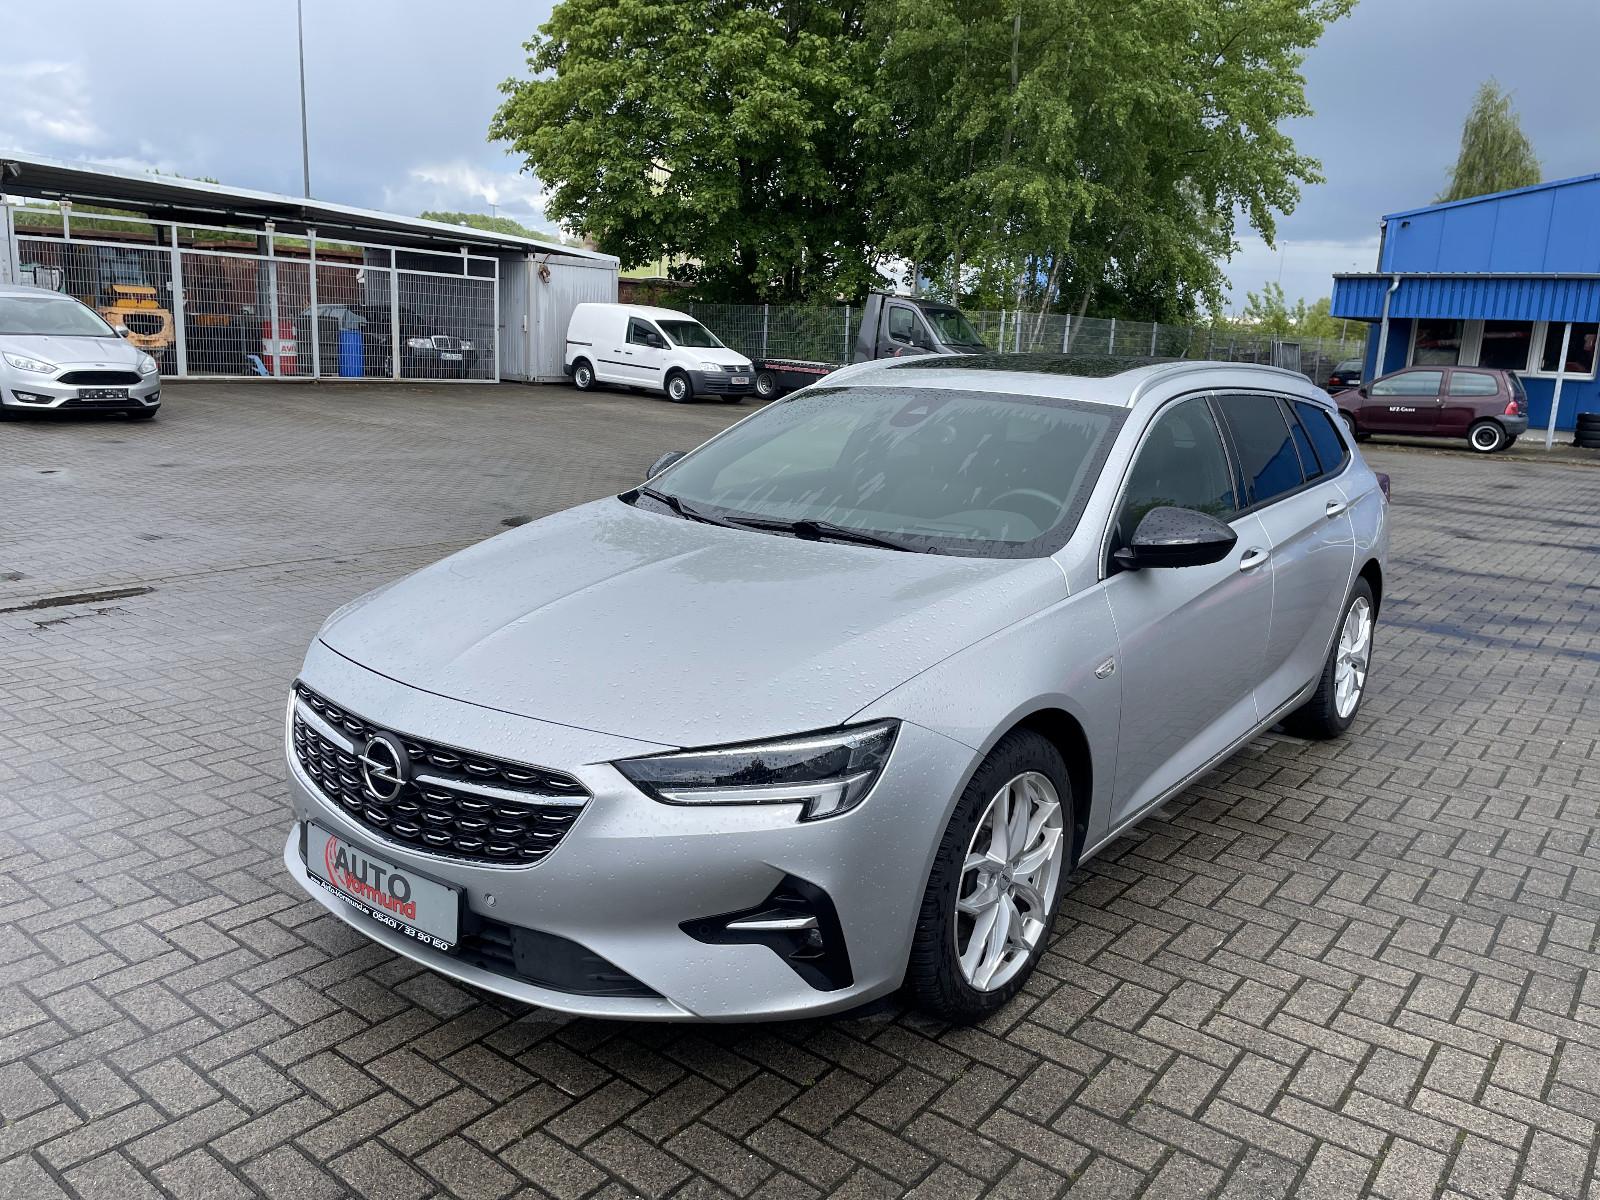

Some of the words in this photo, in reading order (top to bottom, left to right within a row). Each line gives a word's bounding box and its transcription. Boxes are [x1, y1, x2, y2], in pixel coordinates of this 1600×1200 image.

[335, 846, 411, 903] AUTO
[344, 868, 416, 920] Vormund
[372, 911, 397, 929] 05401
[398, 922, 404, 930] /
[404, 925, 415, 937] 33
[417, 931, 431, 943] 90
[432, 937, 448, 951] 150
